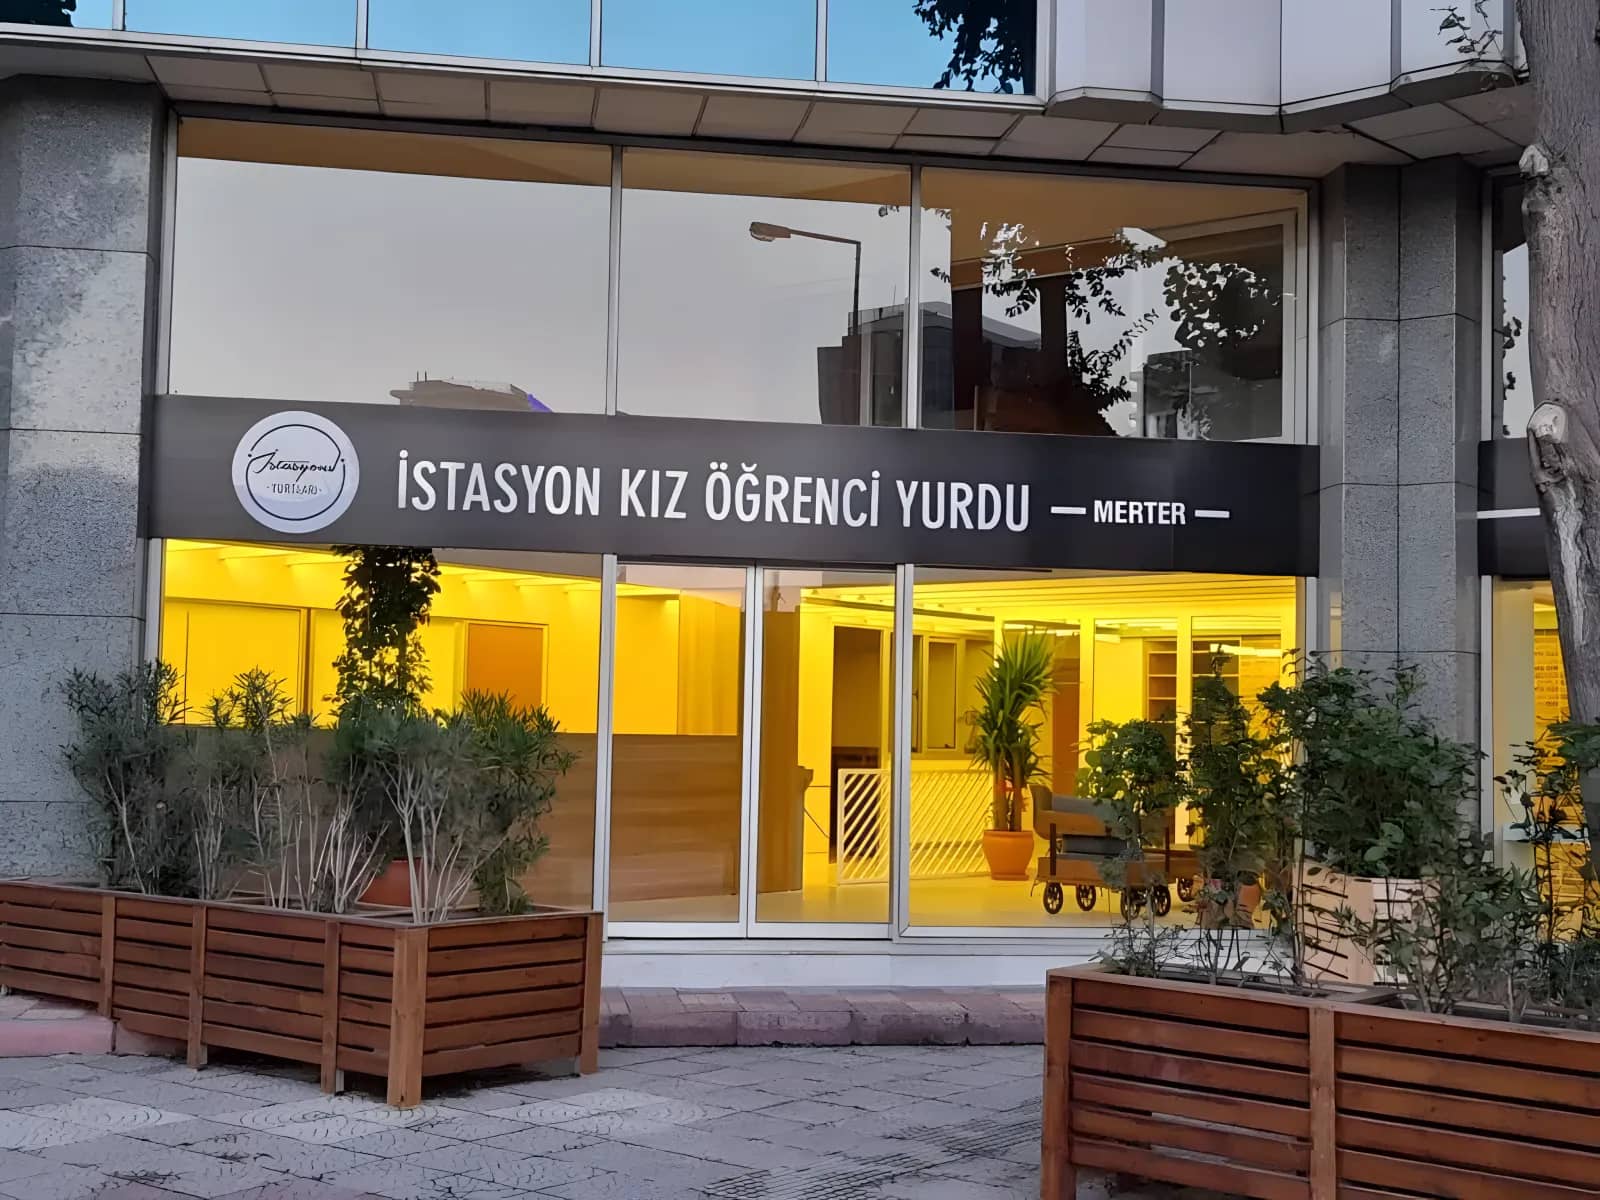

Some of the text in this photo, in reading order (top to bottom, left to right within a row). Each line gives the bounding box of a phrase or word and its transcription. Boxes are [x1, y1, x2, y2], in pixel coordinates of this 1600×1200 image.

[398, 449, 1029, 532] İSTASYON KIZ ÖĞRENCİ YURDU
[1093, 500, 1186, 525] MERTER
